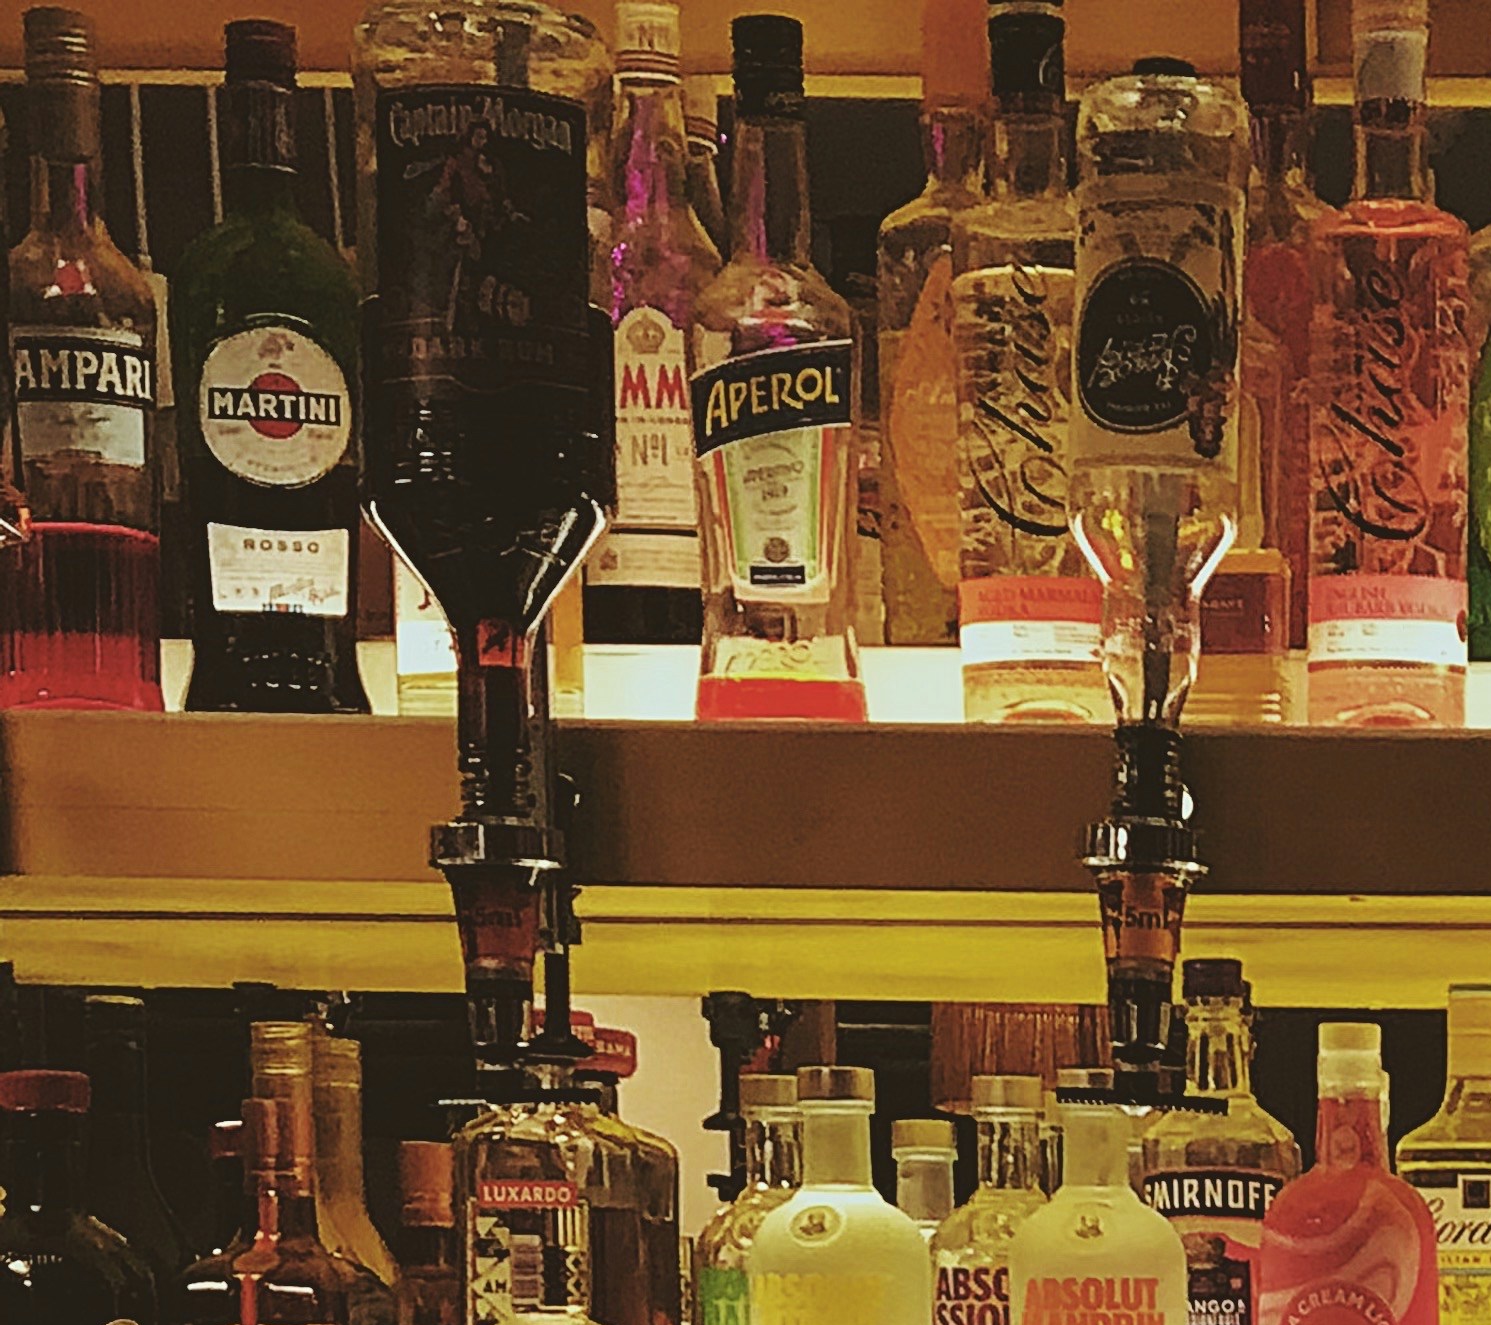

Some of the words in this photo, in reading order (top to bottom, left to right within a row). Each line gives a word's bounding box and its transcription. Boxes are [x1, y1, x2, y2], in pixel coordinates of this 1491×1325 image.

[212, 391, 339, 423] MARTINI
[705, 366, 841, 437] APEROL
[242, 537, 322, 554] ROSSO
[482, 1185, 573, 1204] LUXARDO
[1024, 1277, 1160, 1311] ABSOLUT
[1297, 1287, 1366, 1316] CREAM
